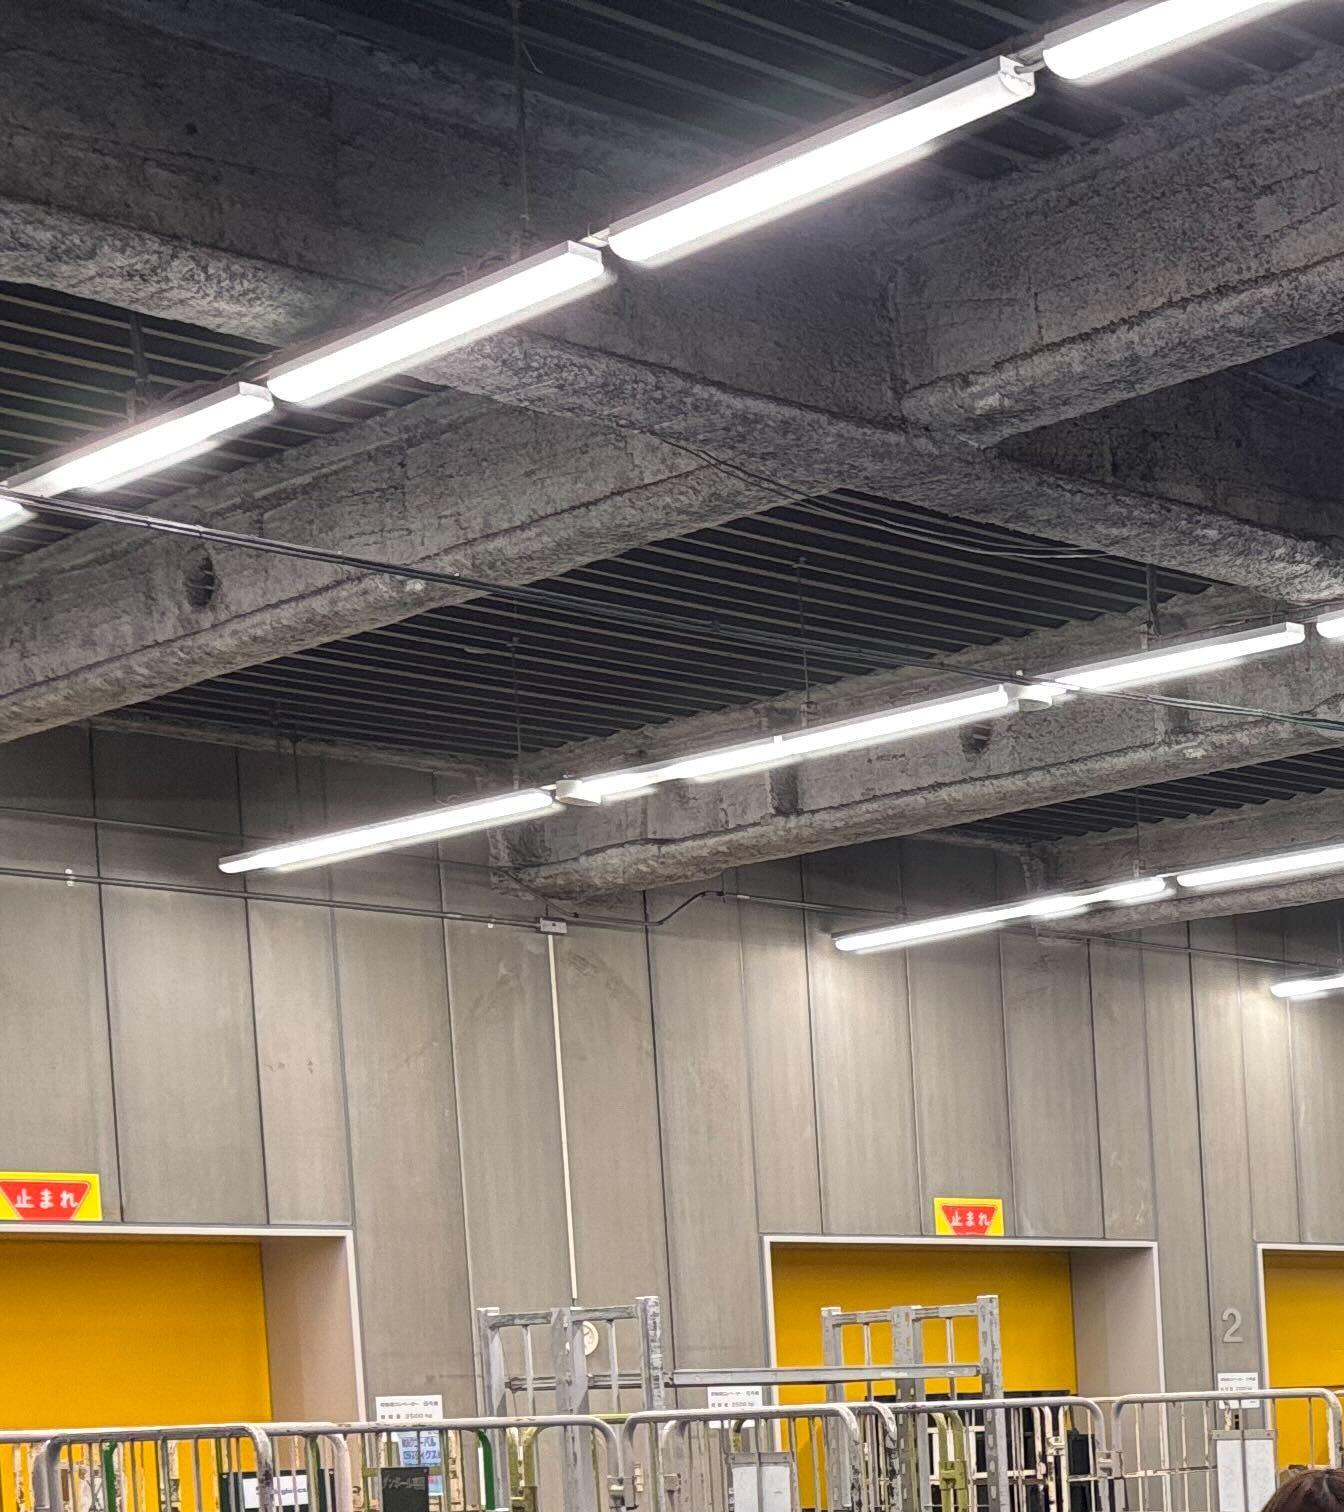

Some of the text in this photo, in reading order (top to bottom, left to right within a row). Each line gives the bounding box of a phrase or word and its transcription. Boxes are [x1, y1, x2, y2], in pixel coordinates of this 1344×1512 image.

[14, 1188, 79, 1209] 止まれ
[951, 1210, 991, 1227] 止まれ
[1223, 1308, 1243, 1343] 2
